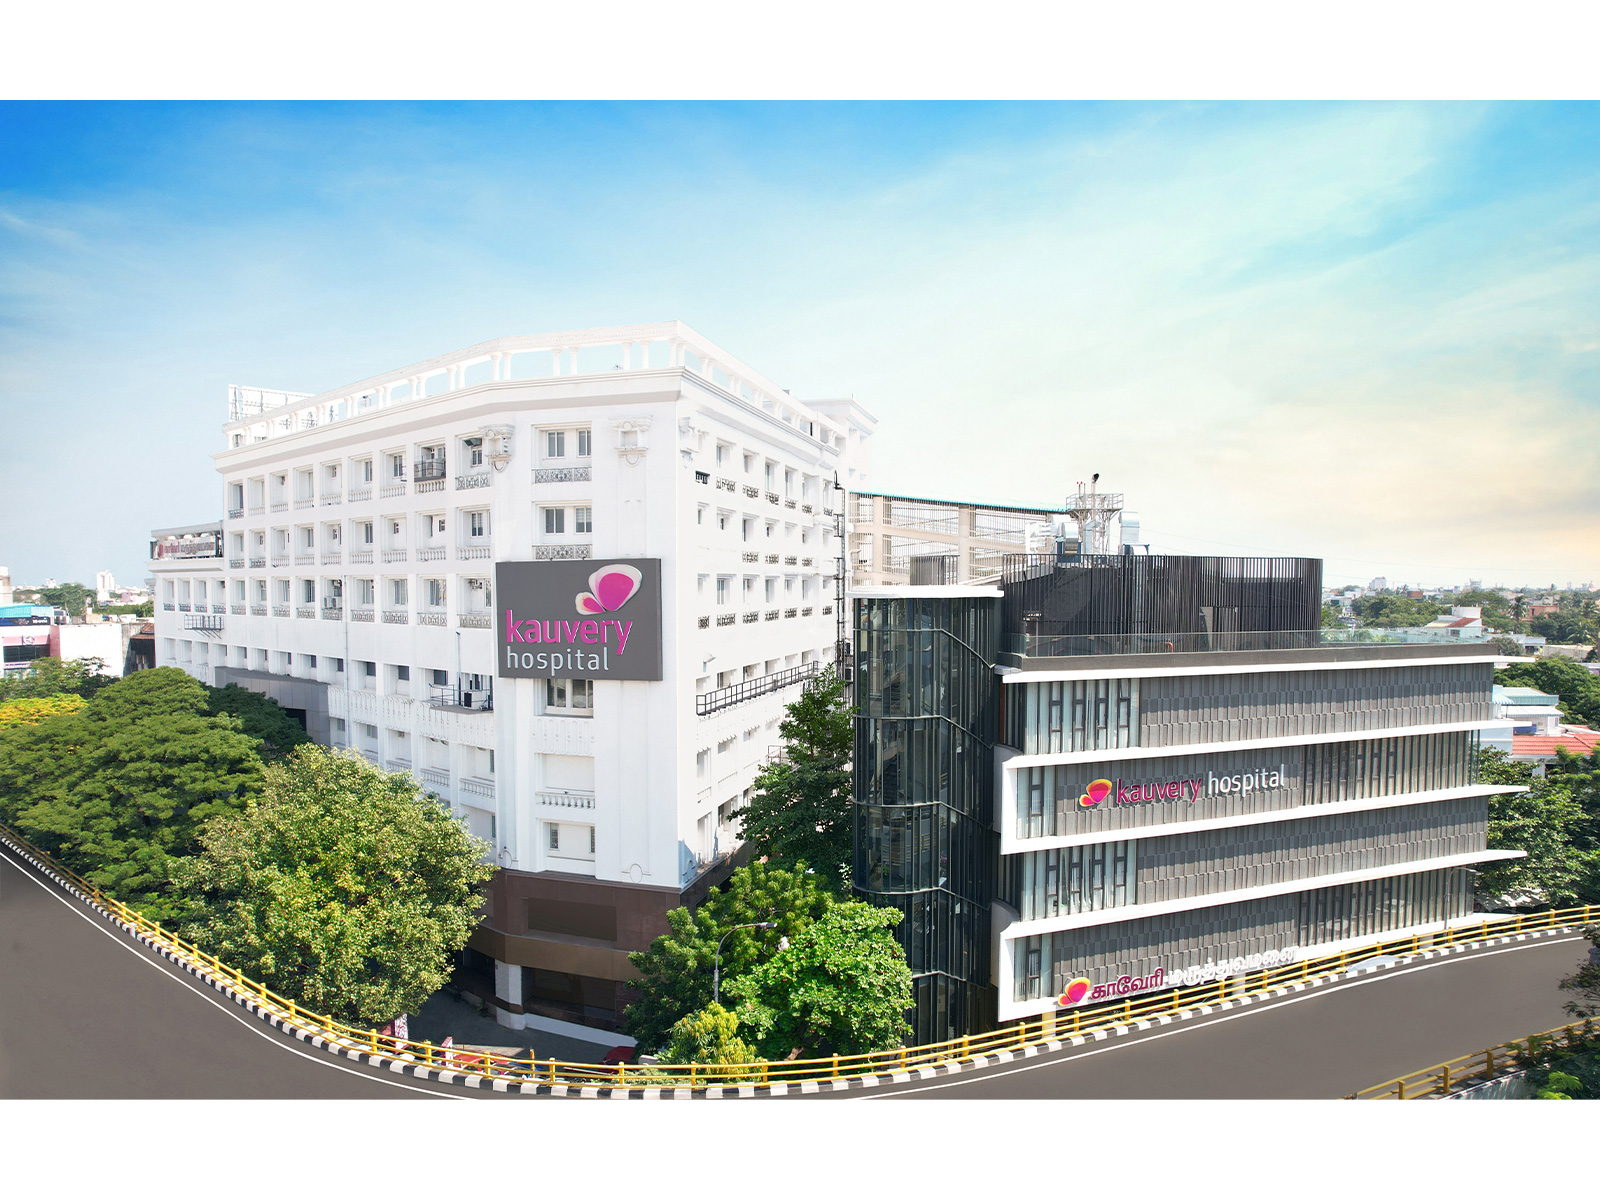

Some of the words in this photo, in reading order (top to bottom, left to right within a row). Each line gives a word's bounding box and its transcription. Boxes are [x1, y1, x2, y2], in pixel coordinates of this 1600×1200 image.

[506, 609, 633, 655] kauvery
[507, 646, 609, 677] hospital
[1117, 778, 1202, 804] kauvery
[1208, 763, 1285, 798] hospital
[1091, 967, 1164, 1000] காவேரி
